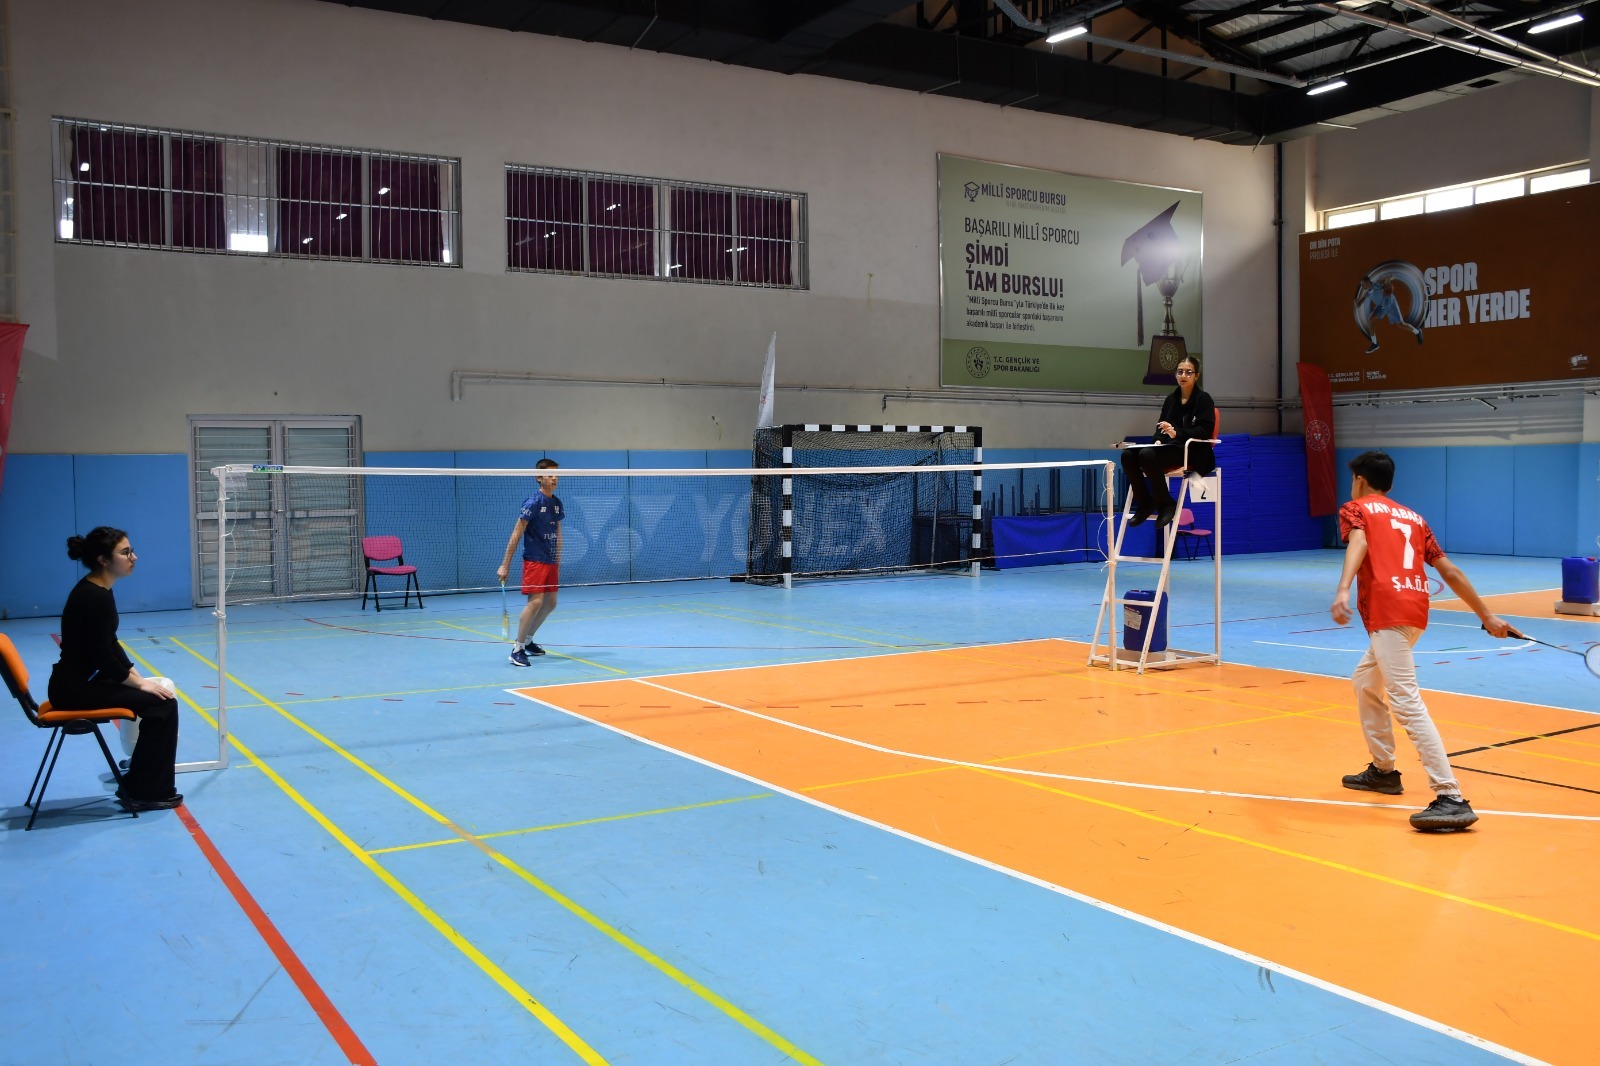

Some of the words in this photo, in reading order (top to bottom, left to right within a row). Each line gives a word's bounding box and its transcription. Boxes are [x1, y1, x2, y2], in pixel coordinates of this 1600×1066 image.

[981, 182, 1004, 198] MİLLÎ
[1005, 187, 1038, 202] SPORCU
[1039, 191, 1066, 206] BURSU
[964, 217, 1010, 238] BAŞARILI
[1013, 221, 1039, 240] MİLLÎ
[1042, 226, 1080, 245] SPORCU
[965, 239, 1009, 269] ŞİMDİ
[965, 269, 997, 293] TAM
[1001, 273, 1064, 298] BURSLU!
[1423, 261, 1478, 296] SPOR
[981, 297, 998, 306] Sporcu
[1424, 297, 1461, 328] HER
[1465, 288, 1531, 324] YERDE
[966, 319, 989, 328] akademik
[998, 311, 1021, 319] sporcular
[993, 364, 1009, 372] SPOR
[1009, 365, 1040, 373] BAKANLIĞI
[1005, 356, 1031, 365] GENÇLİK
[1390, 518, 1415, 570] 7
